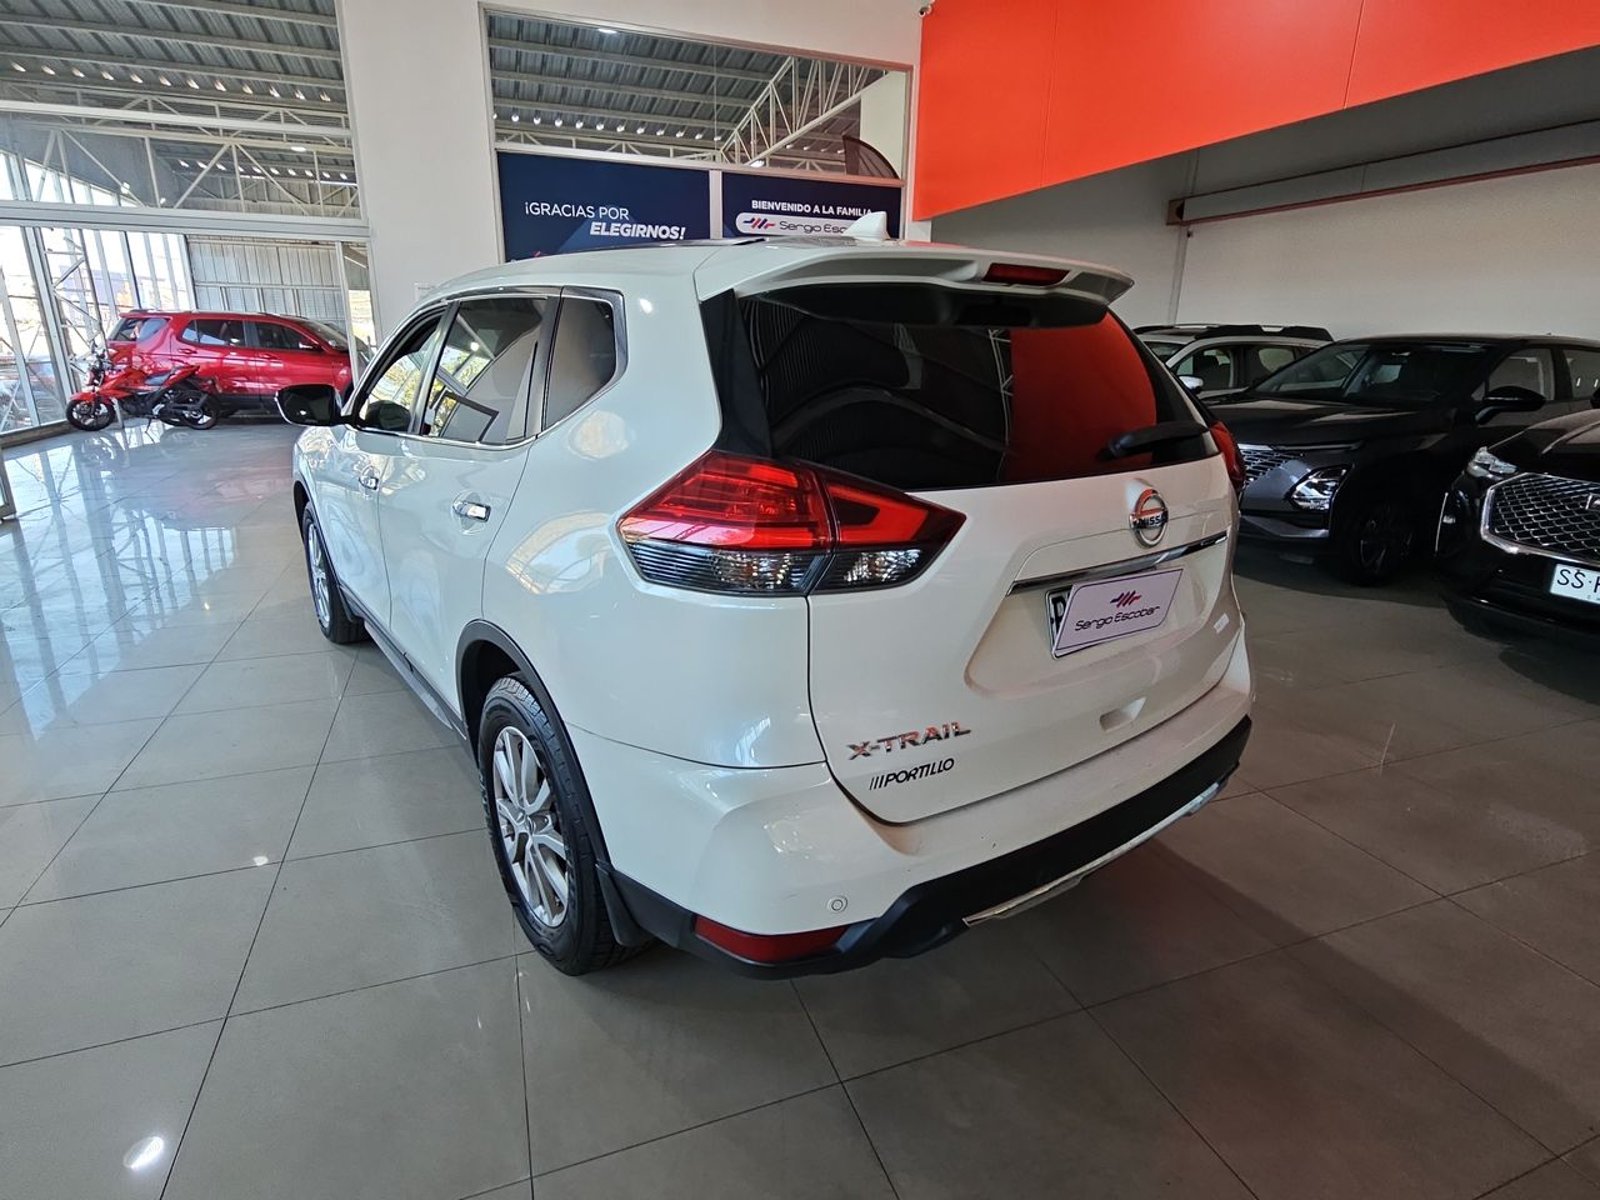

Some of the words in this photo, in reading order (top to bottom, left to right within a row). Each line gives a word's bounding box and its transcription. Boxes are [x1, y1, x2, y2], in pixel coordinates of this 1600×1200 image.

[525, 202, 595, 219] ¡GRACIAS
[599, 206, 630, 220] POR
[751, 200, 811, 213] BIENVENIDO
[822, 207, 835, 216] LA
[836, 207, 873, 217] FAMILIA
[590, 221, 686, 240] ELEGIRNOS!
[779, 221, 822, 234] Sergo
[1075, 615, 1113, 632] Sergo
[847, 721, 971, 760] X-TRAIL
